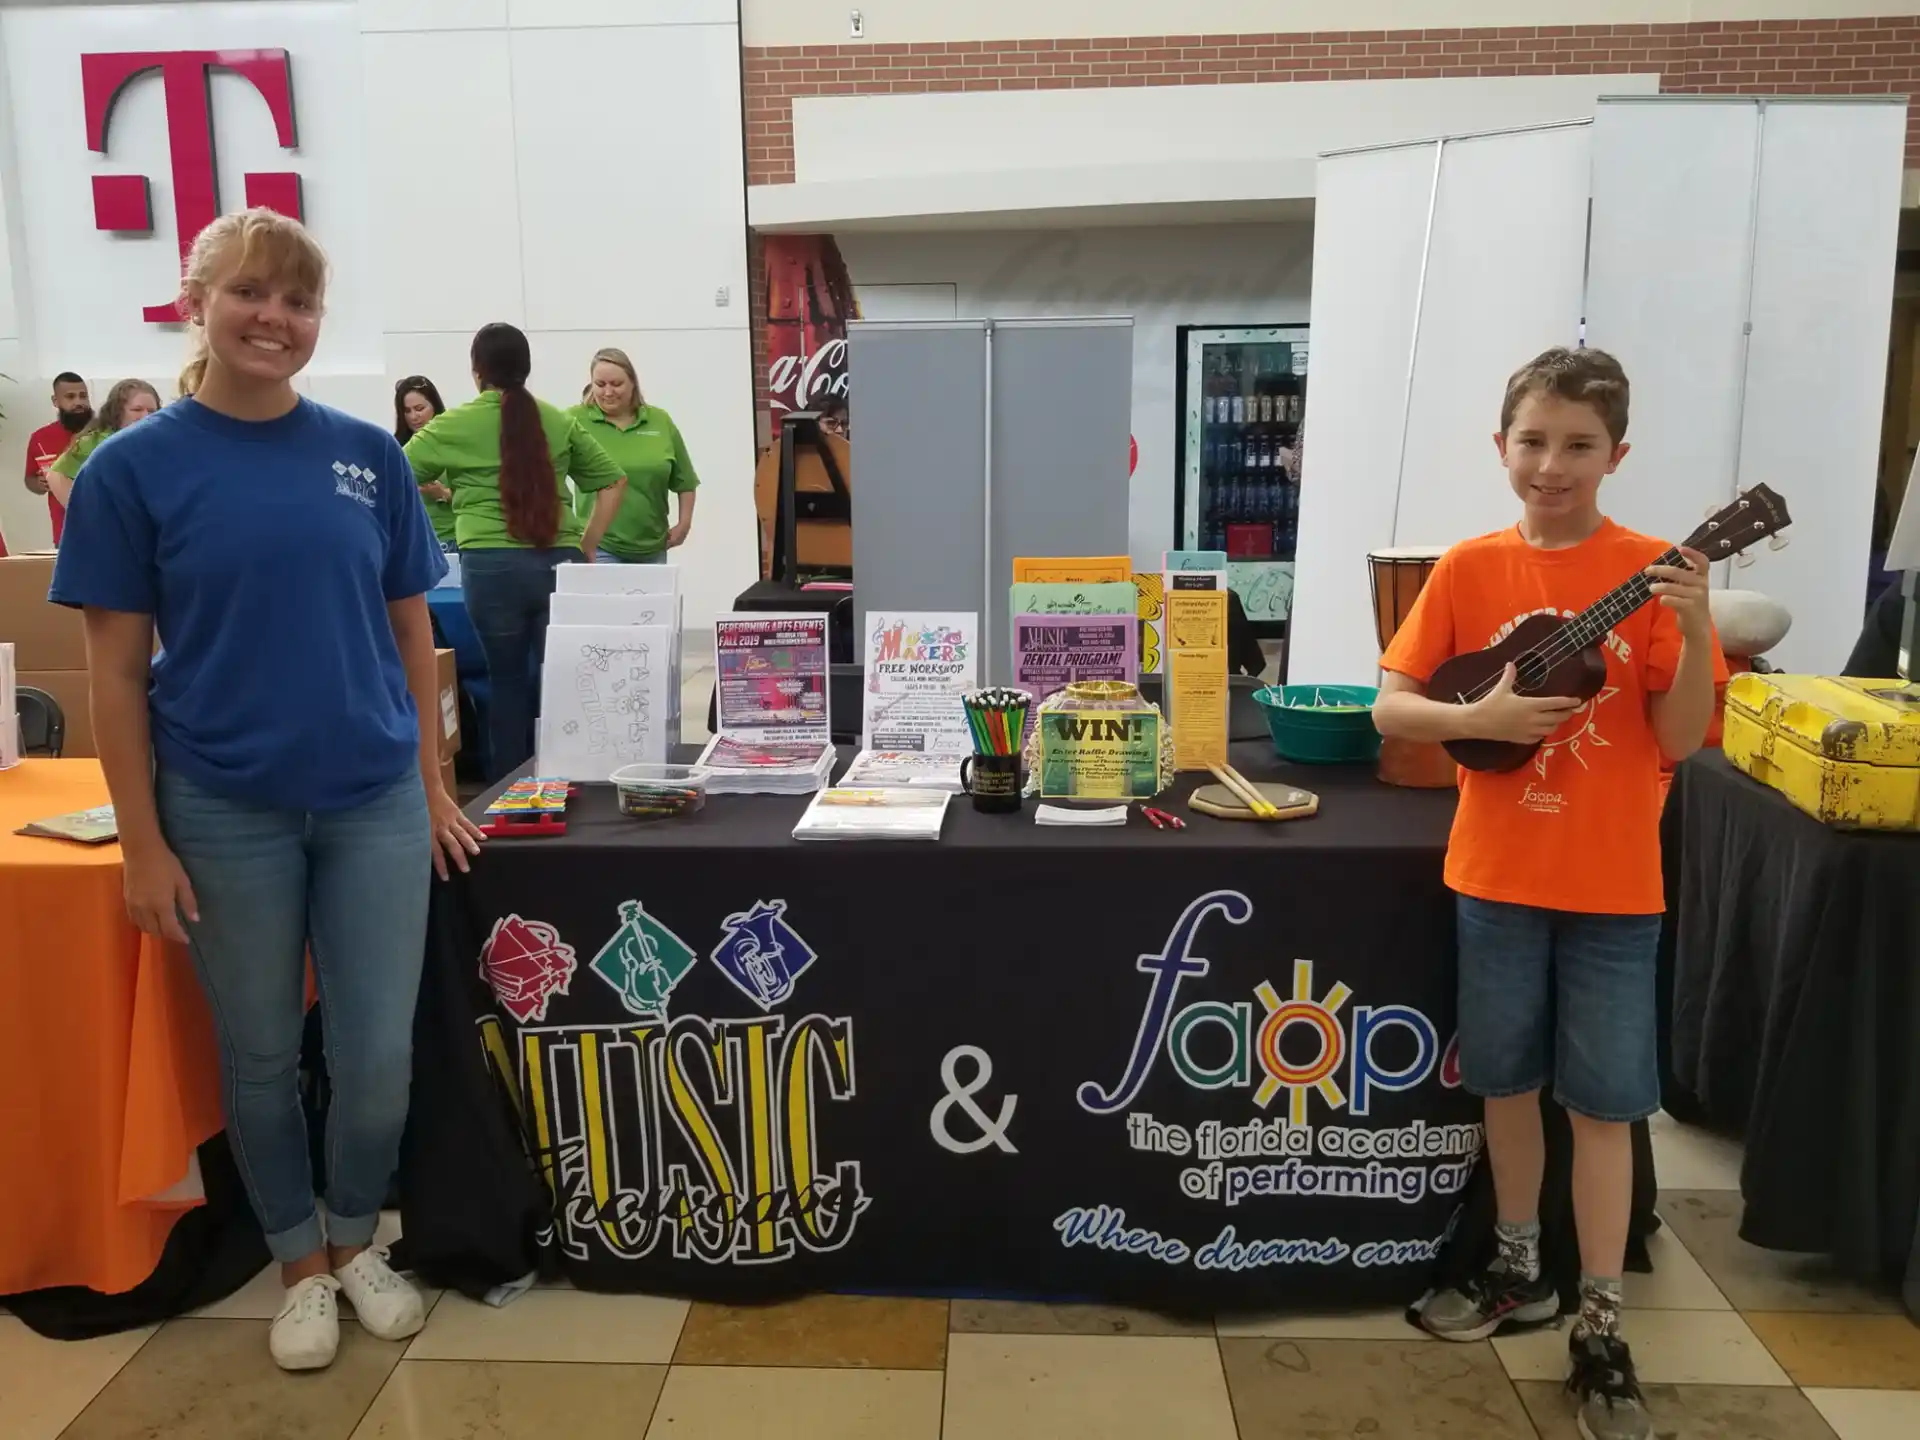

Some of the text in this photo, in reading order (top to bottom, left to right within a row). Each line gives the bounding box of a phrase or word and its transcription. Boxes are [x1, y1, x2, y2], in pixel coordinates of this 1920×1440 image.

[718, 620, 824, 634] PERFORMING ARTS EVENTS
[718, 636, 738, 646] FALL
[739, 635, 760, 646] 2019
[1023, 652, 1123, 666] RENTAL PROGRAM!
[879, 663, 964, 675] FREE WORKSHOP
[1048, 718, 1142, 742] WIN!
[1108, 748, 1149, 757] Drawing
[929, 1044, 1019, 1154] &
[1127, 1113, 1485, 1160] the florida academ
[1179, 1165, 1223, 1201] of
[1224, 1162, 1427, 1206] performing
[1052, 1205, 1189, 1265] Where
[1194, 1225, 1347, 1272] dreams
